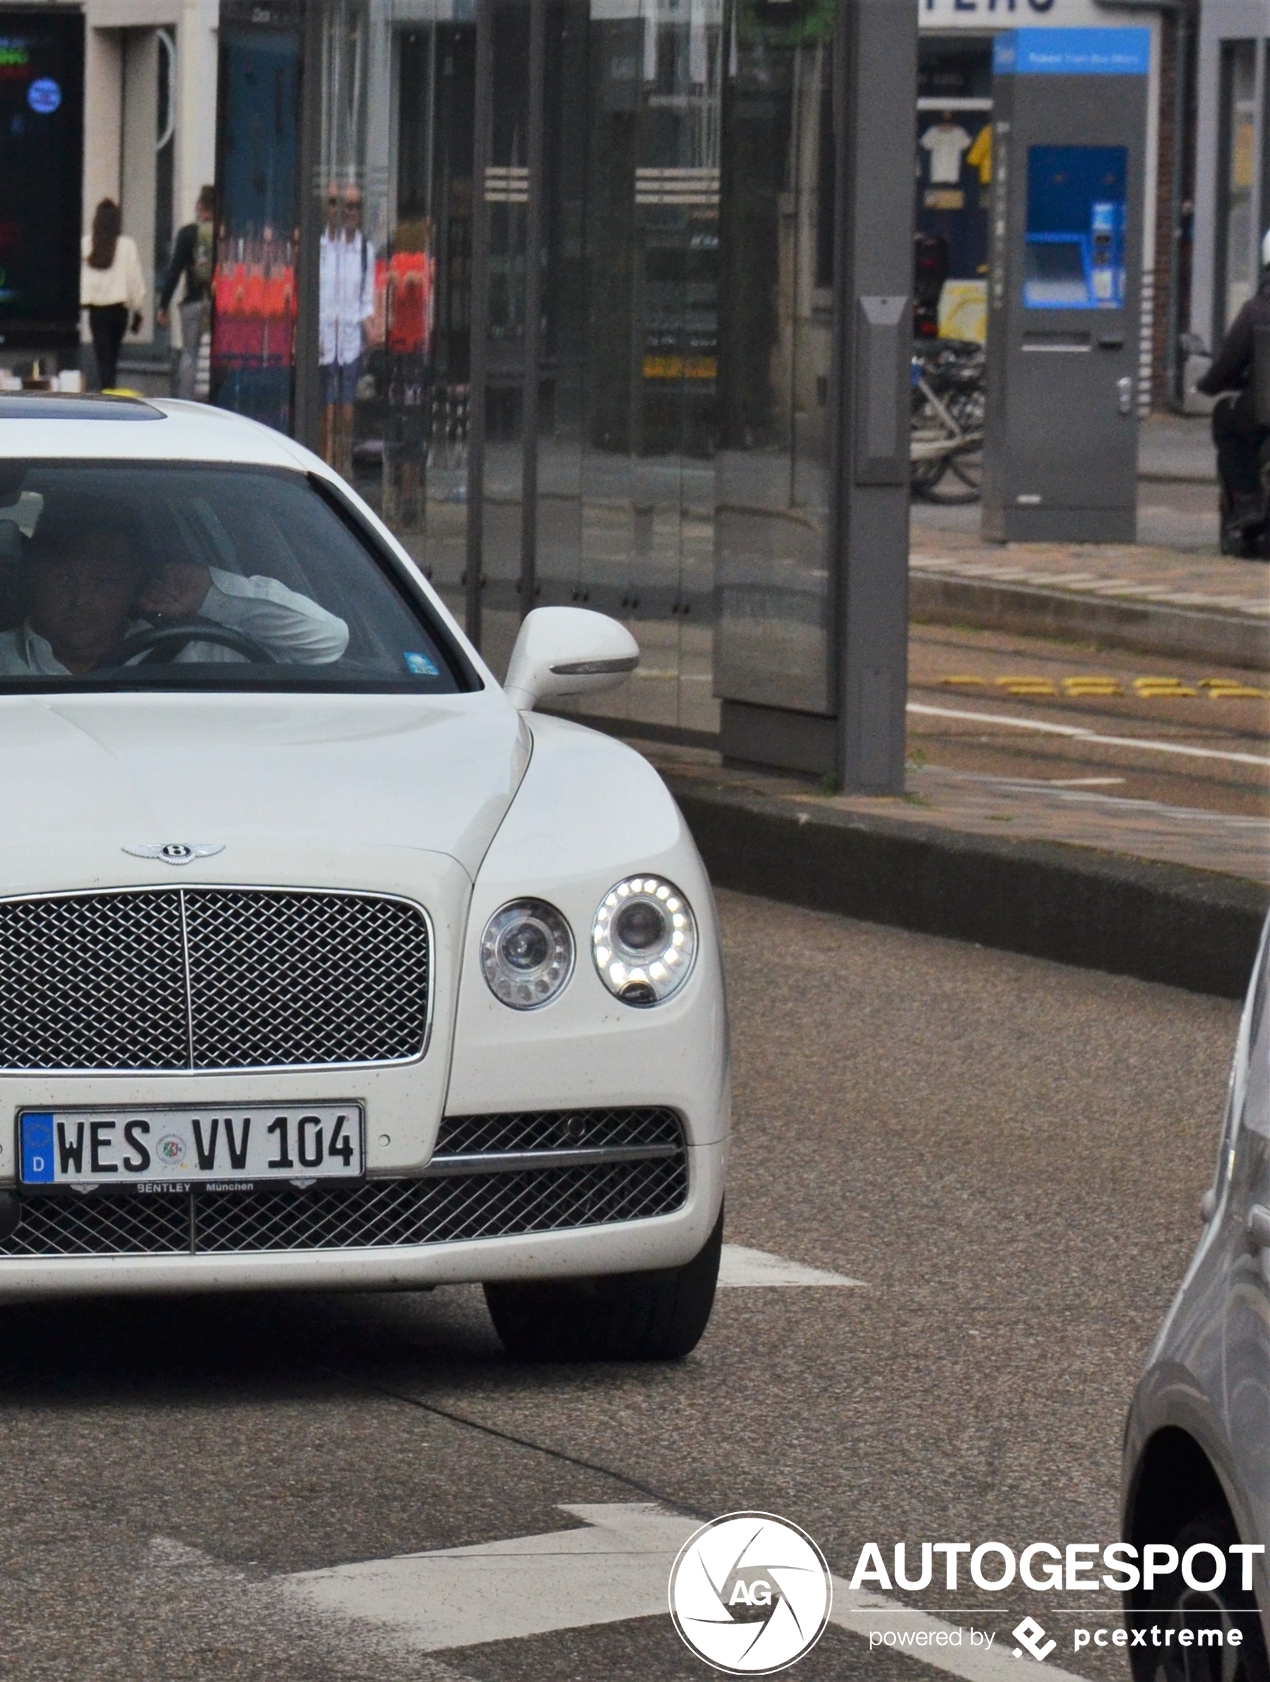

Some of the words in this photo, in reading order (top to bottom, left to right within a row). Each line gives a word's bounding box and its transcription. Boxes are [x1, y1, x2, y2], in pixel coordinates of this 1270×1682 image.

[56, 1119, 151, 1174] WES
[191, 1117, 252, 1171] VV
[267, 1115, 354, 1169] 104
[33, 1156, 45, 1172] D
[137, 1183, 191, 1193] BENTLEY
[206, 1182, 254, 1192] München
